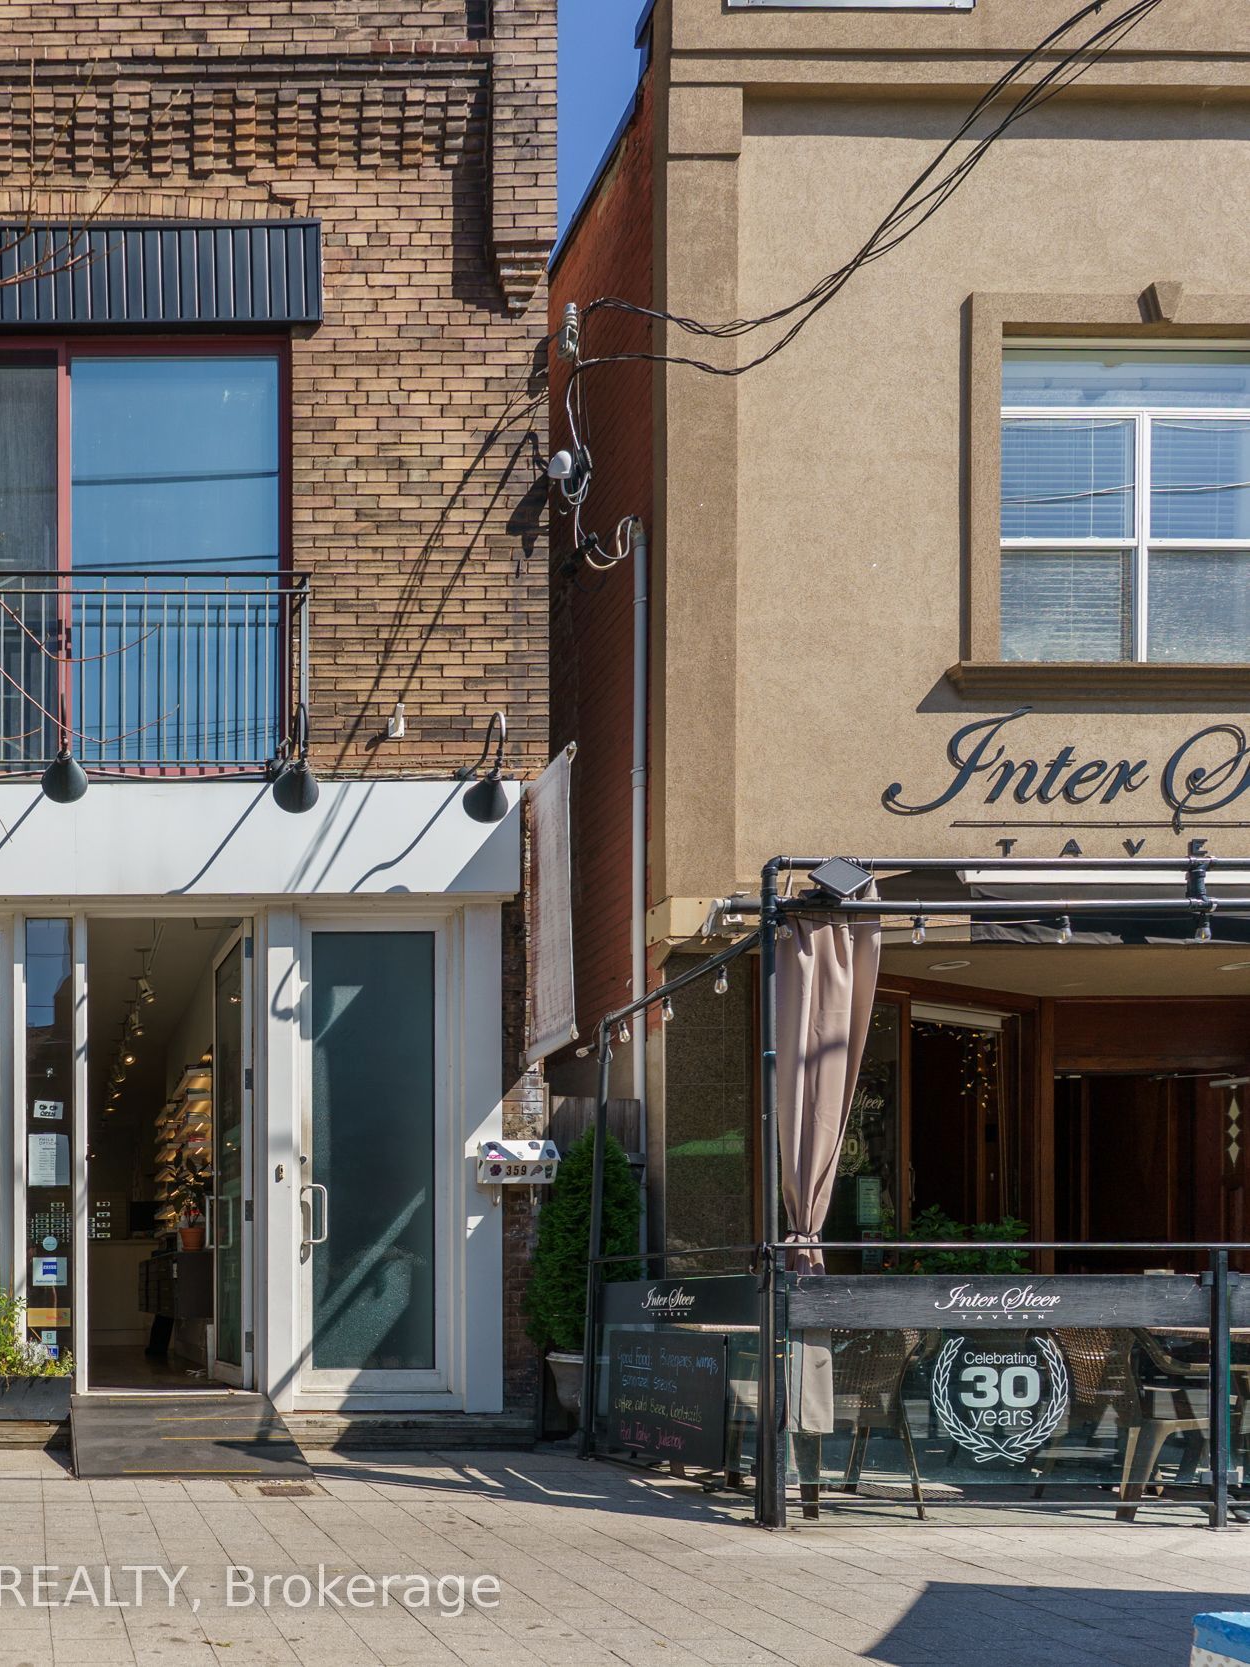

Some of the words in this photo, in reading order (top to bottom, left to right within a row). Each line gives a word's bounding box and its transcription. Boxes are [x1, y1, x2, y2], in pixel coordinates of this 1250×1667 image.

[881, 706, 1149, 815] Inter
[506, 1164, 527, 1176] 359
[641, 1286, 668, 1309] Inter
[668, 1286, 696, 1310] Steer
[934, 1284, 999, 1310] Inter
[1001, 1284, 1061, 1314] Steer
[964, 1351, 1037, 1367] Celebrating
[960, 1366, 1040, 1408] 30
[969, 1408, 1033, 1431] years
